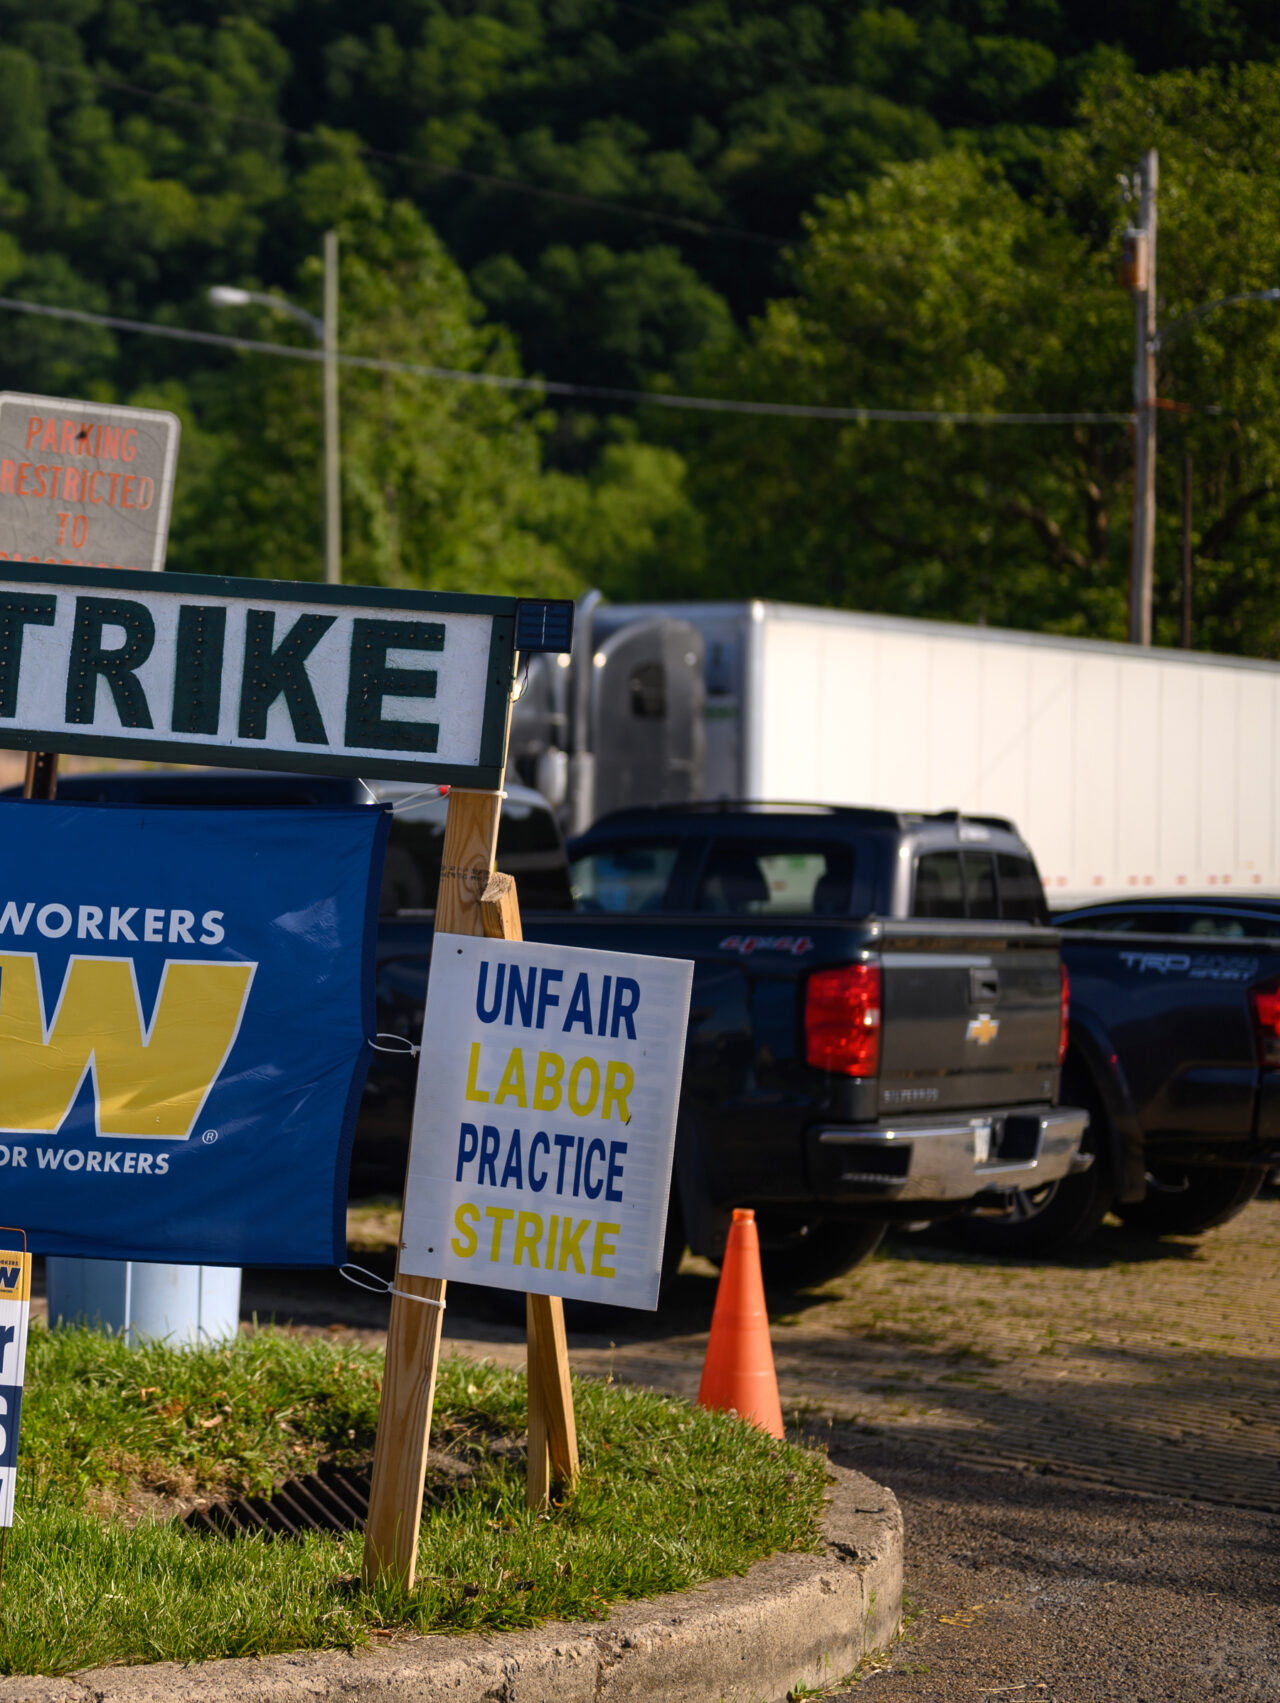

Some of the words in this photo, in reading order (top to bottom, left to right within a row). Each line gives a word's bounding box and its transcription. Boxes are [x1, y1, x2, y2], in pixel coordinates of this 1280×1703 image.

[26, 416, 138, 462] PARKING
[0, 459, 154, 510] RESTRICTED
[58, 513, 88, 548] TO
[1119, 952, 1190, 974] TRD
[476, 961, 641, 1040] UNFAIR
[465, 1042, 635, 1123] LABOR
[35, 1148, 170, 1175] WORKERS
[455, 1122, 628, 1203] PRACTICE
[450, 1202, 621, 1278] STRIKE
